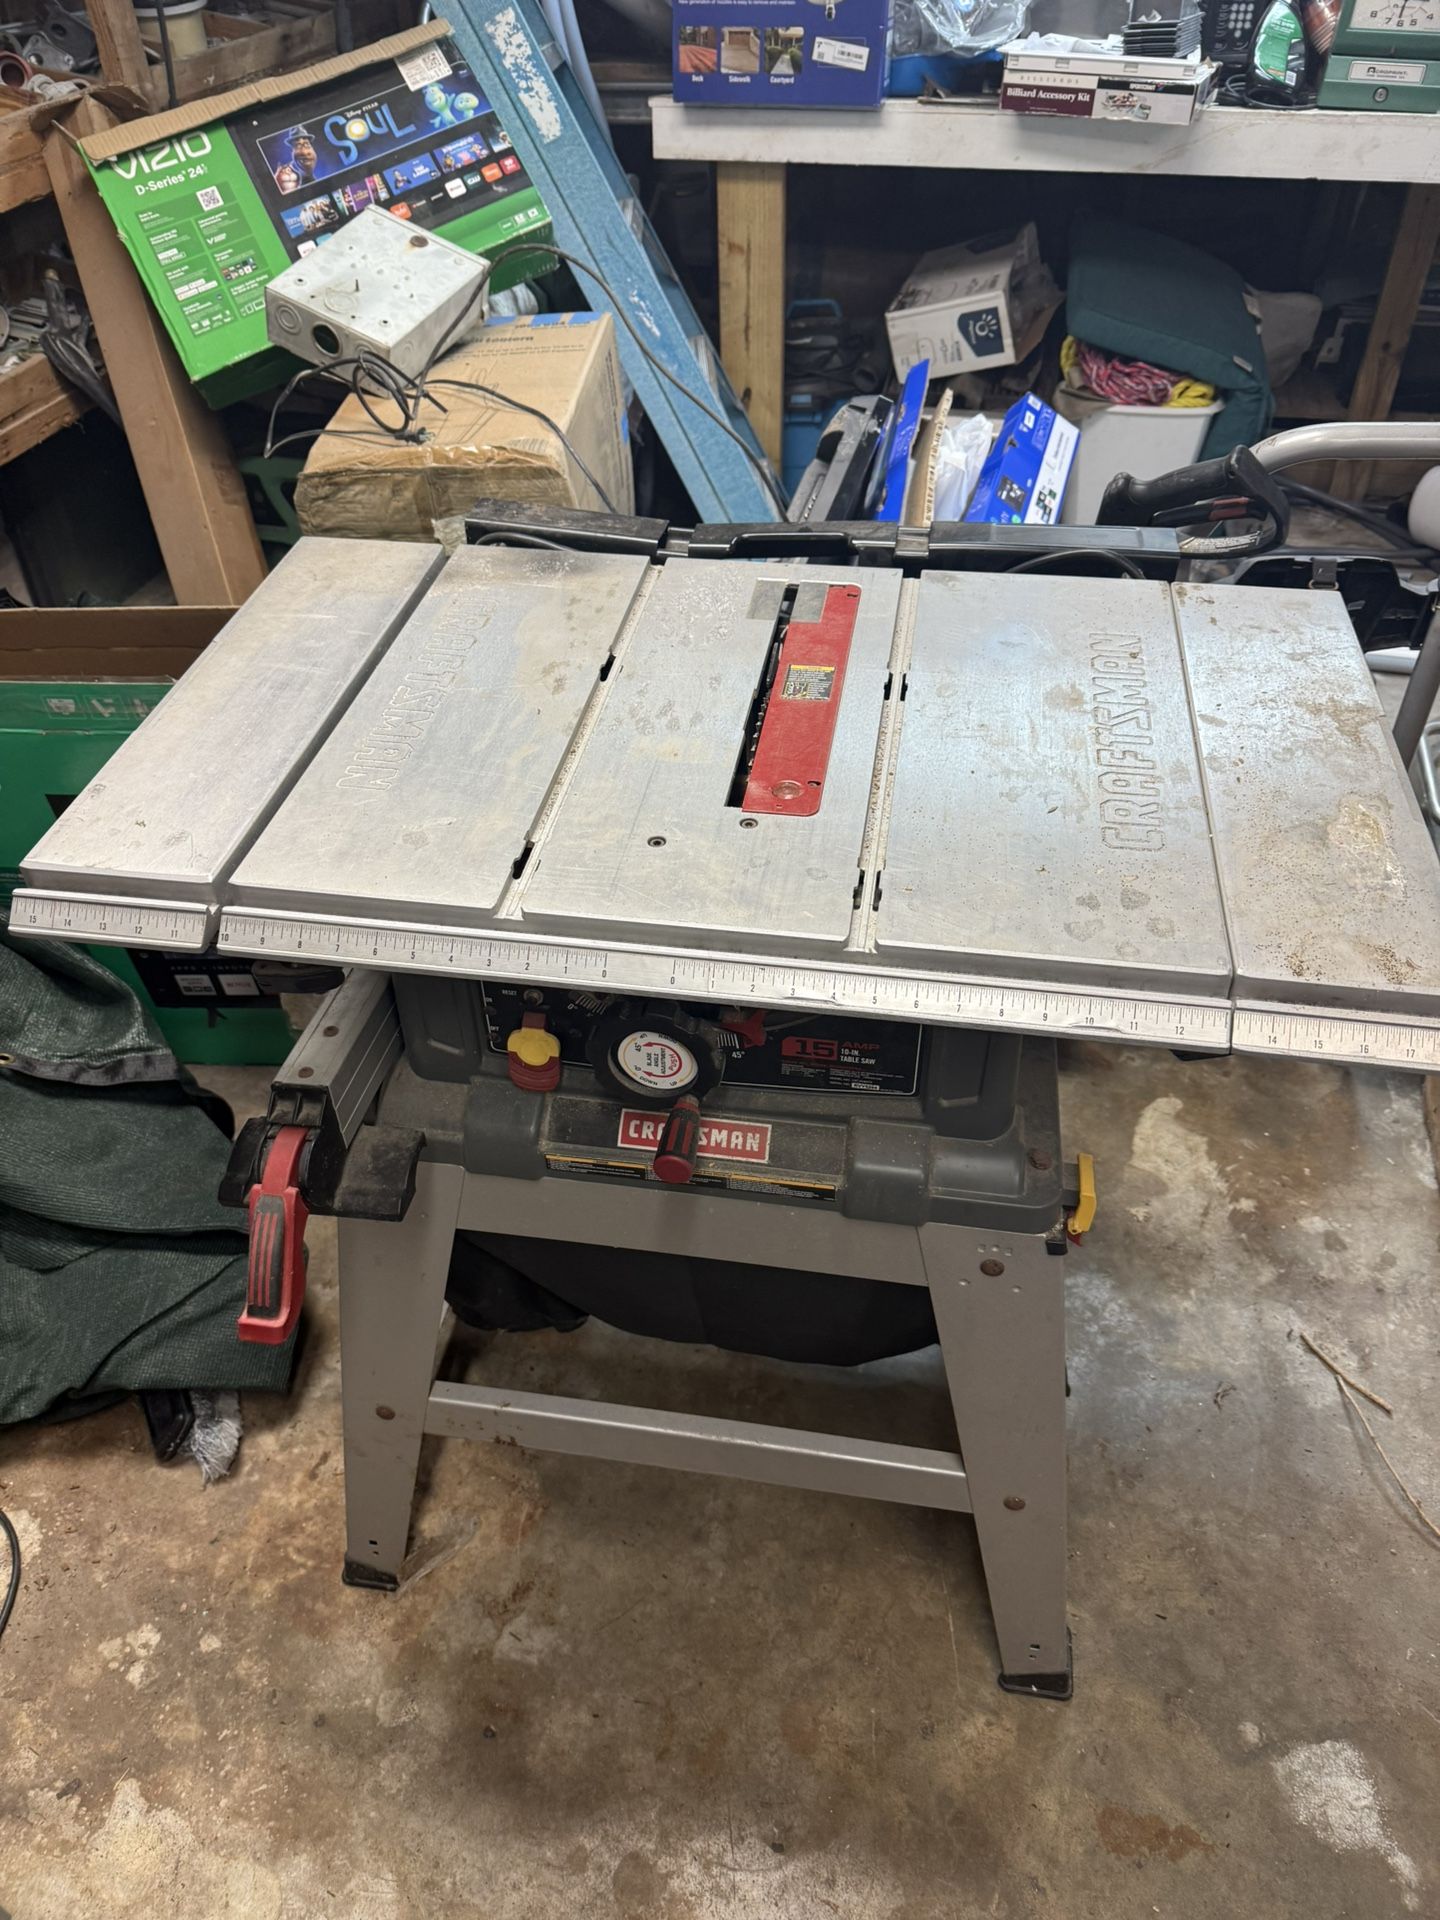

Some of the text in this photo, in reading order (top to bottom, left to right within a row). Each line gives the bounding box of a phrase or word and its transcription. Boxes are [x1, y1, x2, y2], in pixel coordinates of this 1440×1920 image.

[1370, 10, 1378, 18] 8
[1006, 87, 1091, 103] Billiard Accessory Kit
[1090, 632, 1166, 852] CRAFTSMAN
[29, 915, 178, 939] 15 14 13 12 11
[221, 933, 607, 978] 10 9 8 7 6 5 4 3 2 1 0
[670, 976, 675, 985] 0
[711, 980, 715, 988] 1
[750, 984, 755, 993] 2
[790, 987, 796, 997] 3
[872, 996, 878, 1004] 5
[914, 999, 919, 1008] 6
[957, 1003, 962, 1013] 7
[999, 1008, 1004, 1017] 8
[1042, 1012, 1048, 1022] 9
[1130, 1021, 1138, 1031] 11
[1176, 1026, 1185, 1036] 12
[731, 1050, 745, 1060] 45°
[795, 1039, 881, 1057] 15 AMP
[840, 1048, 861, 1056] 10-IN.
[1268, 1035, 1416, 1058] 14 15 16 17
[668, 1053, 678, 1071] PUSH
[839, 1055, 877, 1065] TABLE SAW
[628, 1119, 761, 1152] CRSMAN
